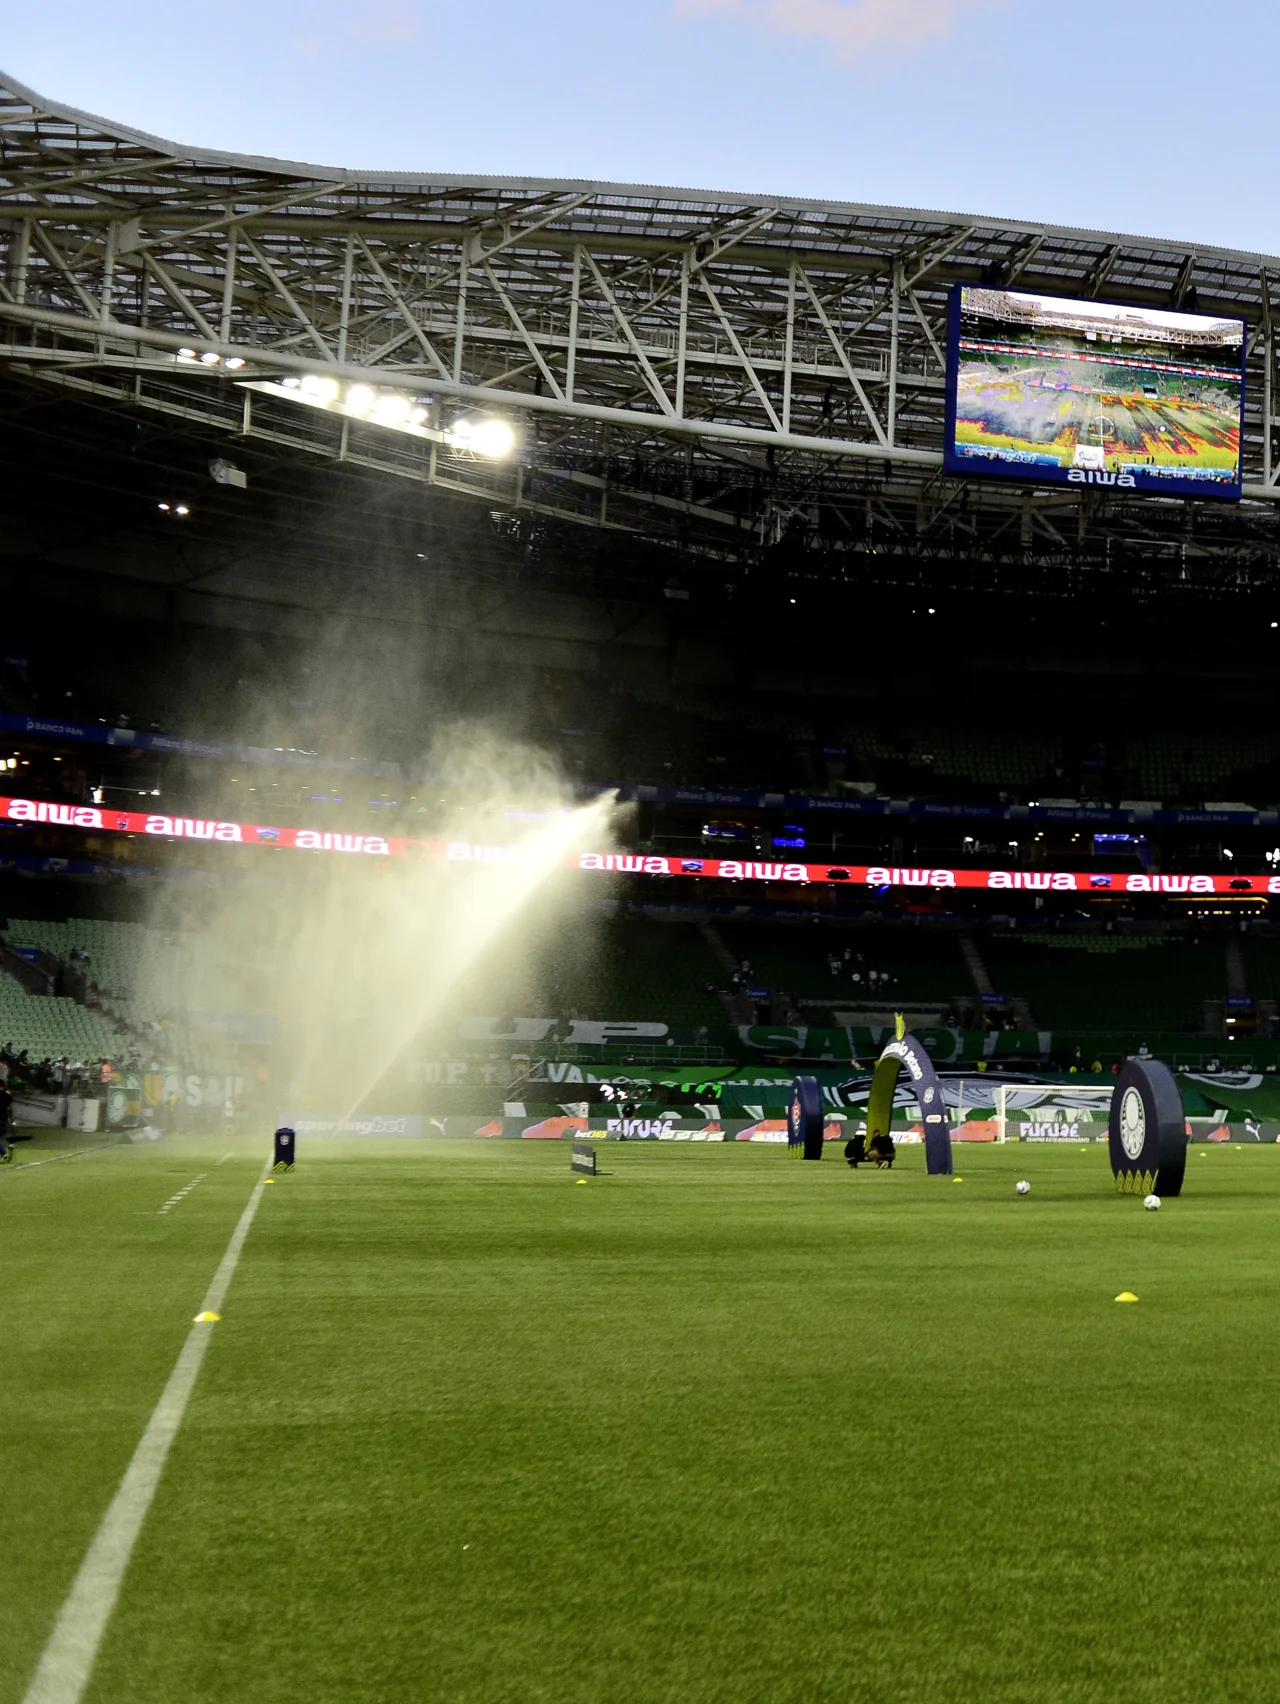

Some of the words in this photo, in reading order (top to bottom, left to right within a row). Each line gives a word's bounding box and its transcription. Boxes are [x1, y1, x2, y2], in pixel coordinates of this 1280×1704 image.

[1067, 469, 1136, 488] aiwa
[35, 723, 64, 733] BANCO
[65, 728, 84, 736] PAN
[8, 799, 102, 829] aiwa
[145, 815, 243, 842] aiwa
[295, 830, 390, 854] aiwa
[578, 852, 669, 874] aiwa
[718, 860, 809, 882] aiwa
[865, 866, 956, 888] aiwa
[987, 870, 1077, 892] aiwa
[1125, 873, 1215, 894] aiwa
[1019, 1122, 1080, 1138] FUTURE
